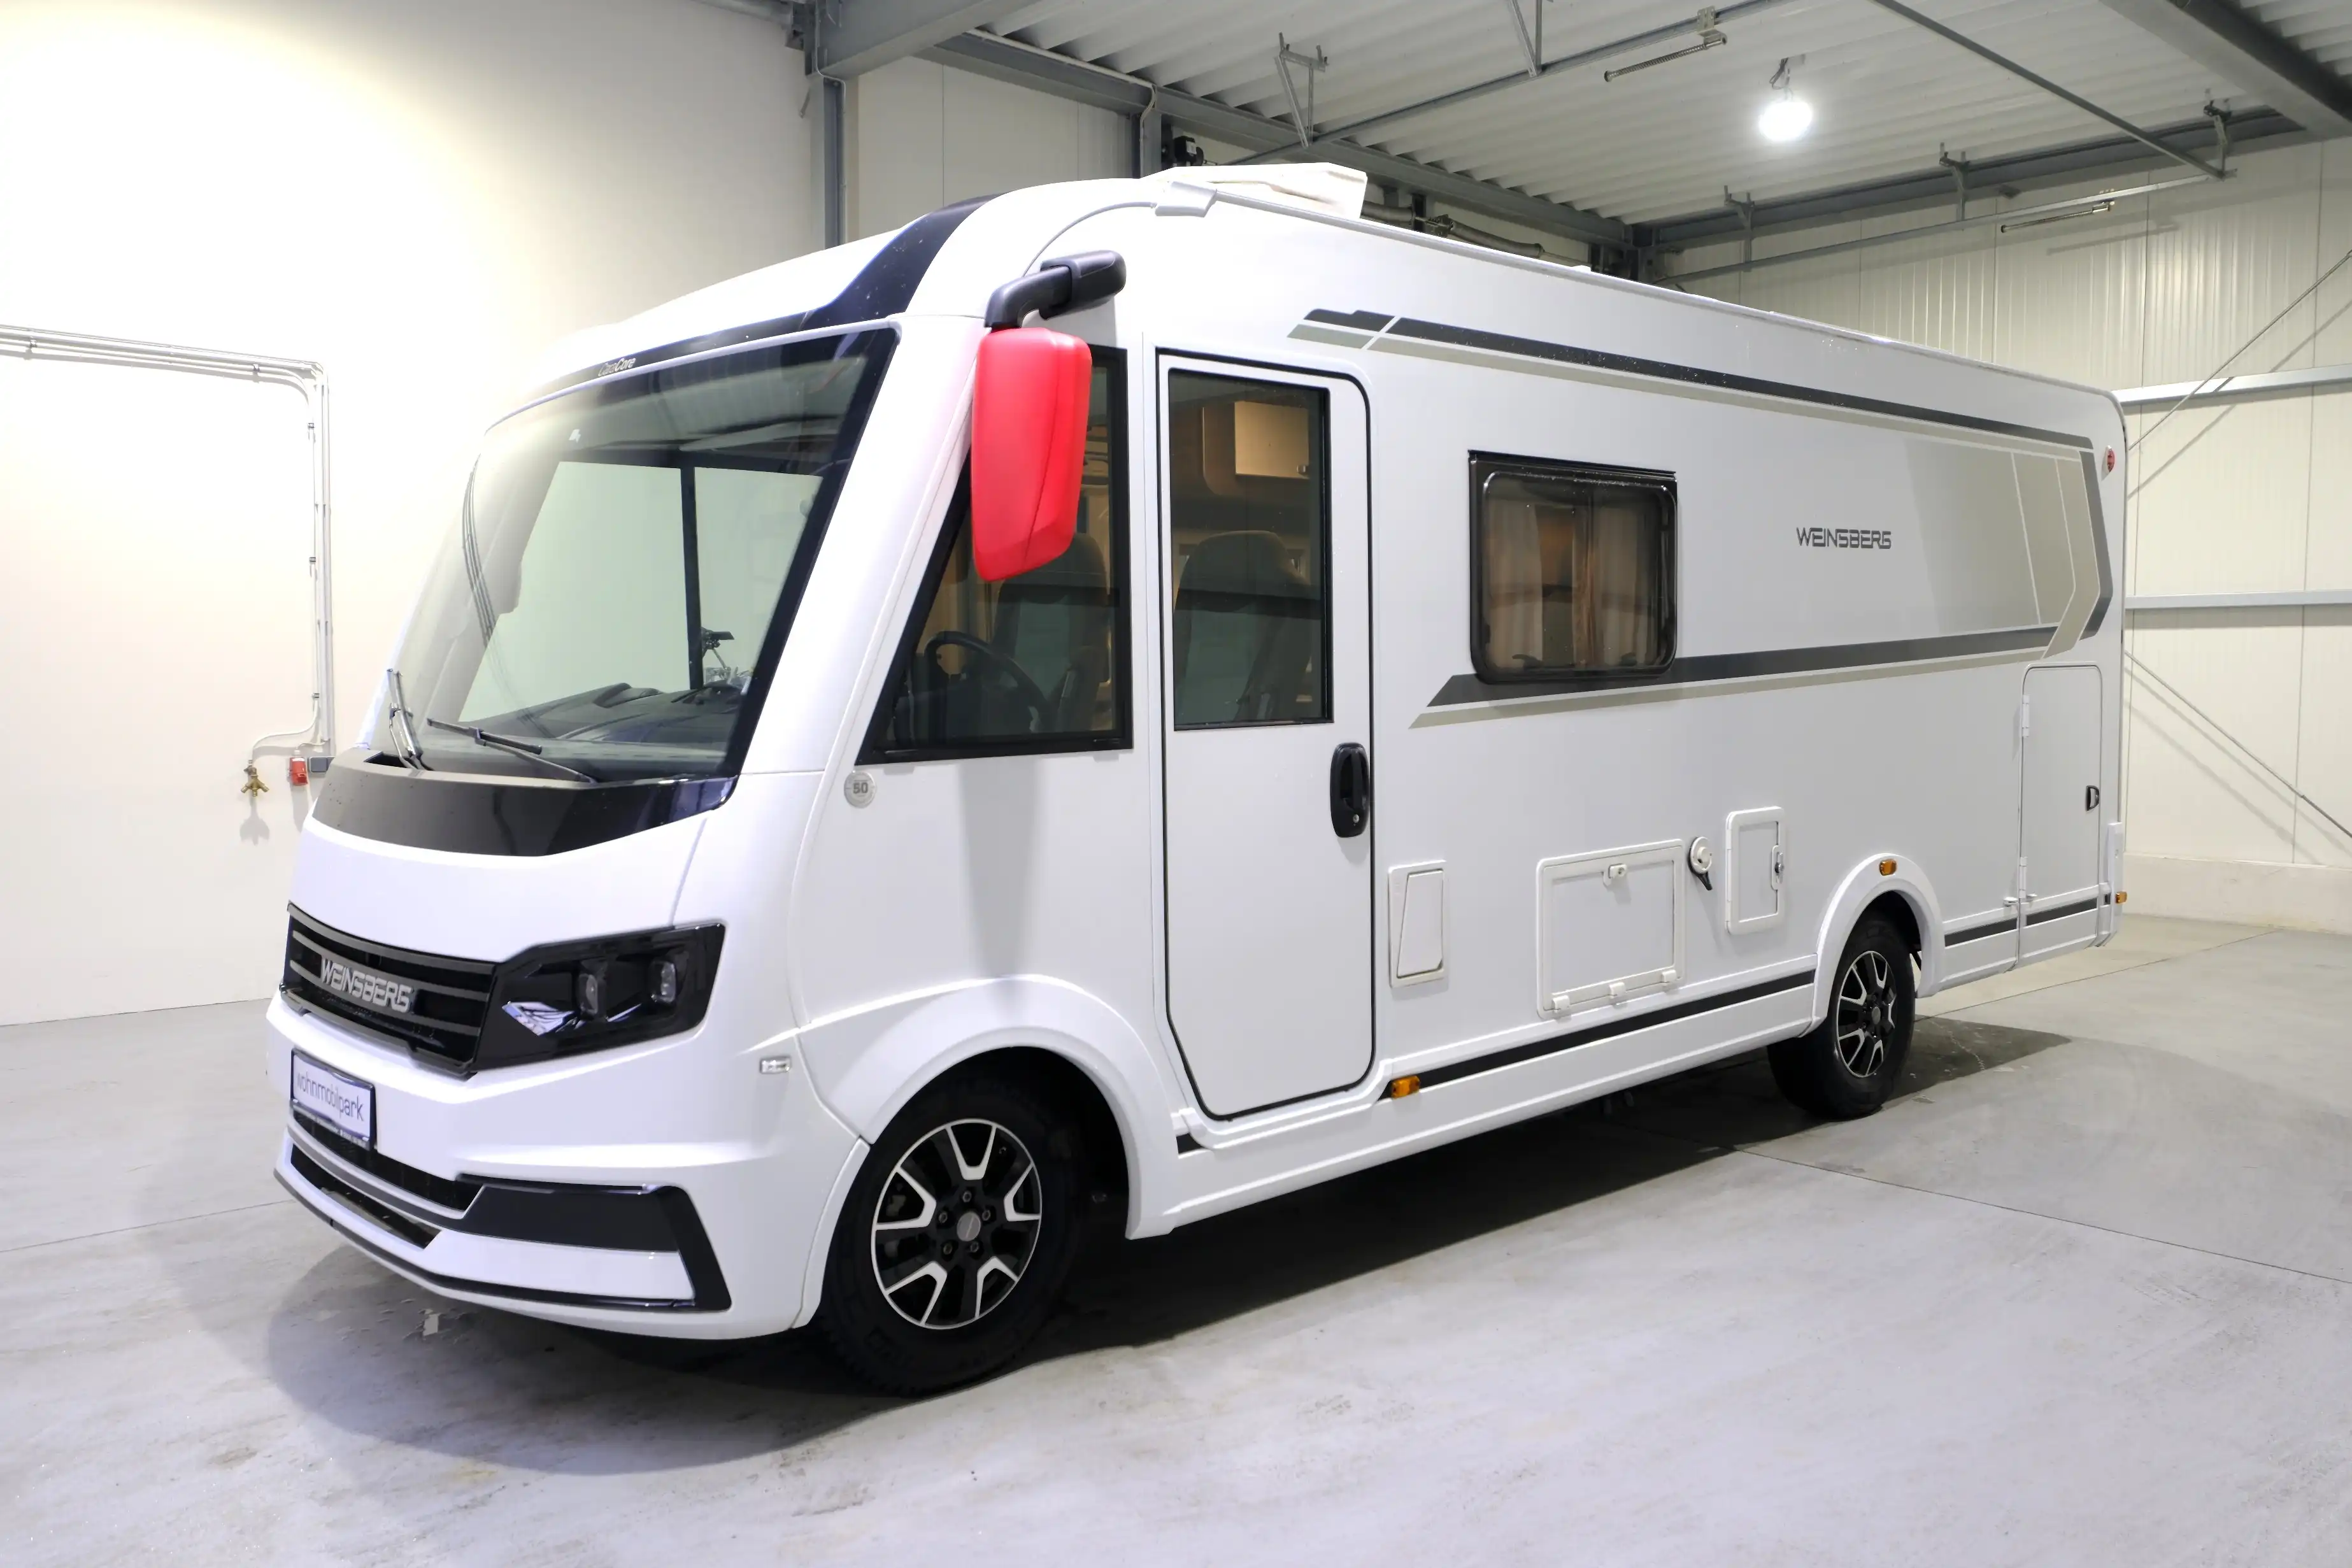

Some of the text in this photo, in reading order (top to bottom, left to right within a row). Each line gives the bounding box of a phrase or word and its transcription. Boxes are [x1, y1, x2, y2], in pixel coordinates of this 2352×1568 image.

[1796, 527, 1892, 550] WEINSBERG
[853, 782, 868, 794] 50
[322, 957, 412, 1013] WEINSBERG
